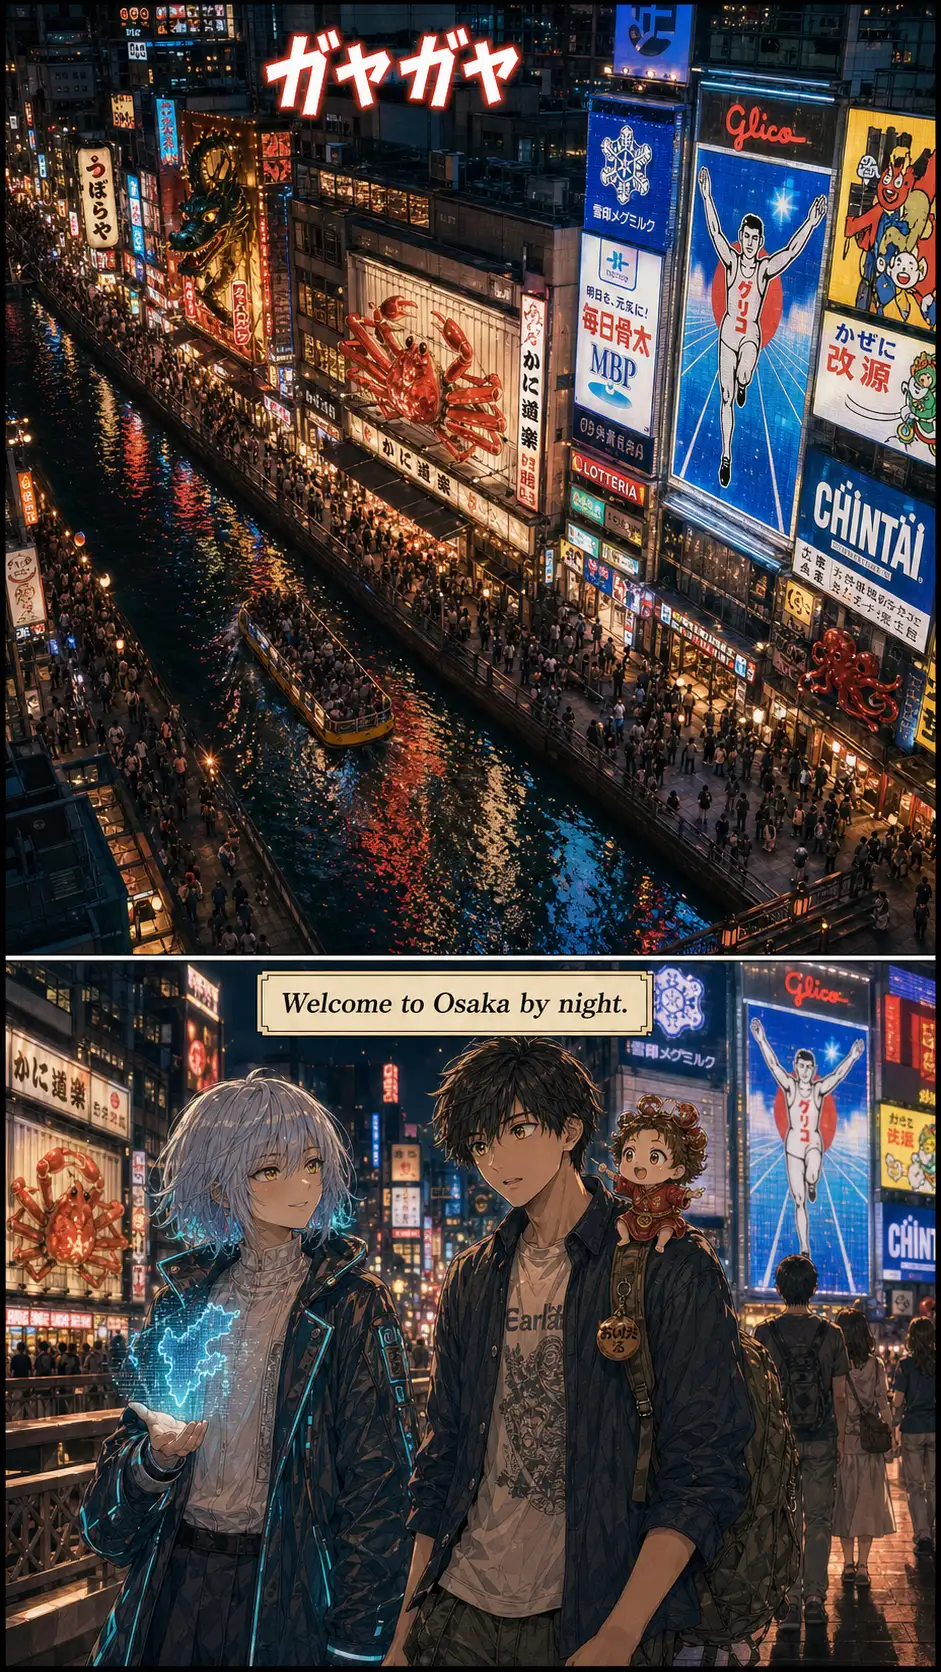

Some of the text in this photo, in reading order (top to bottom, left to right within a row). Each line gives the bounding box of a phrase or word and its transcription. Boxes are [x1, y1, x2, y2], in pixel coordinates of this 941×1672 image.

[725, 104, 806, 151] Glico
[86, 156, 112, 241] うぼらや
[592, 203, 656, 233] 雪印メグミルク
[582, 302, 652, 358] 毎日骨太
[735, 281, 754, 335] グリコ
[834, 323, 897, 360] かぜに
[590, 343, 637, 390] MBP
[826, 344, 892, 394] 改源
[583, 463, 638, 501] LOTTERIA
[784, 970, 848, 1007] Glico
[797, 1098, 811, 1145] グリコ
